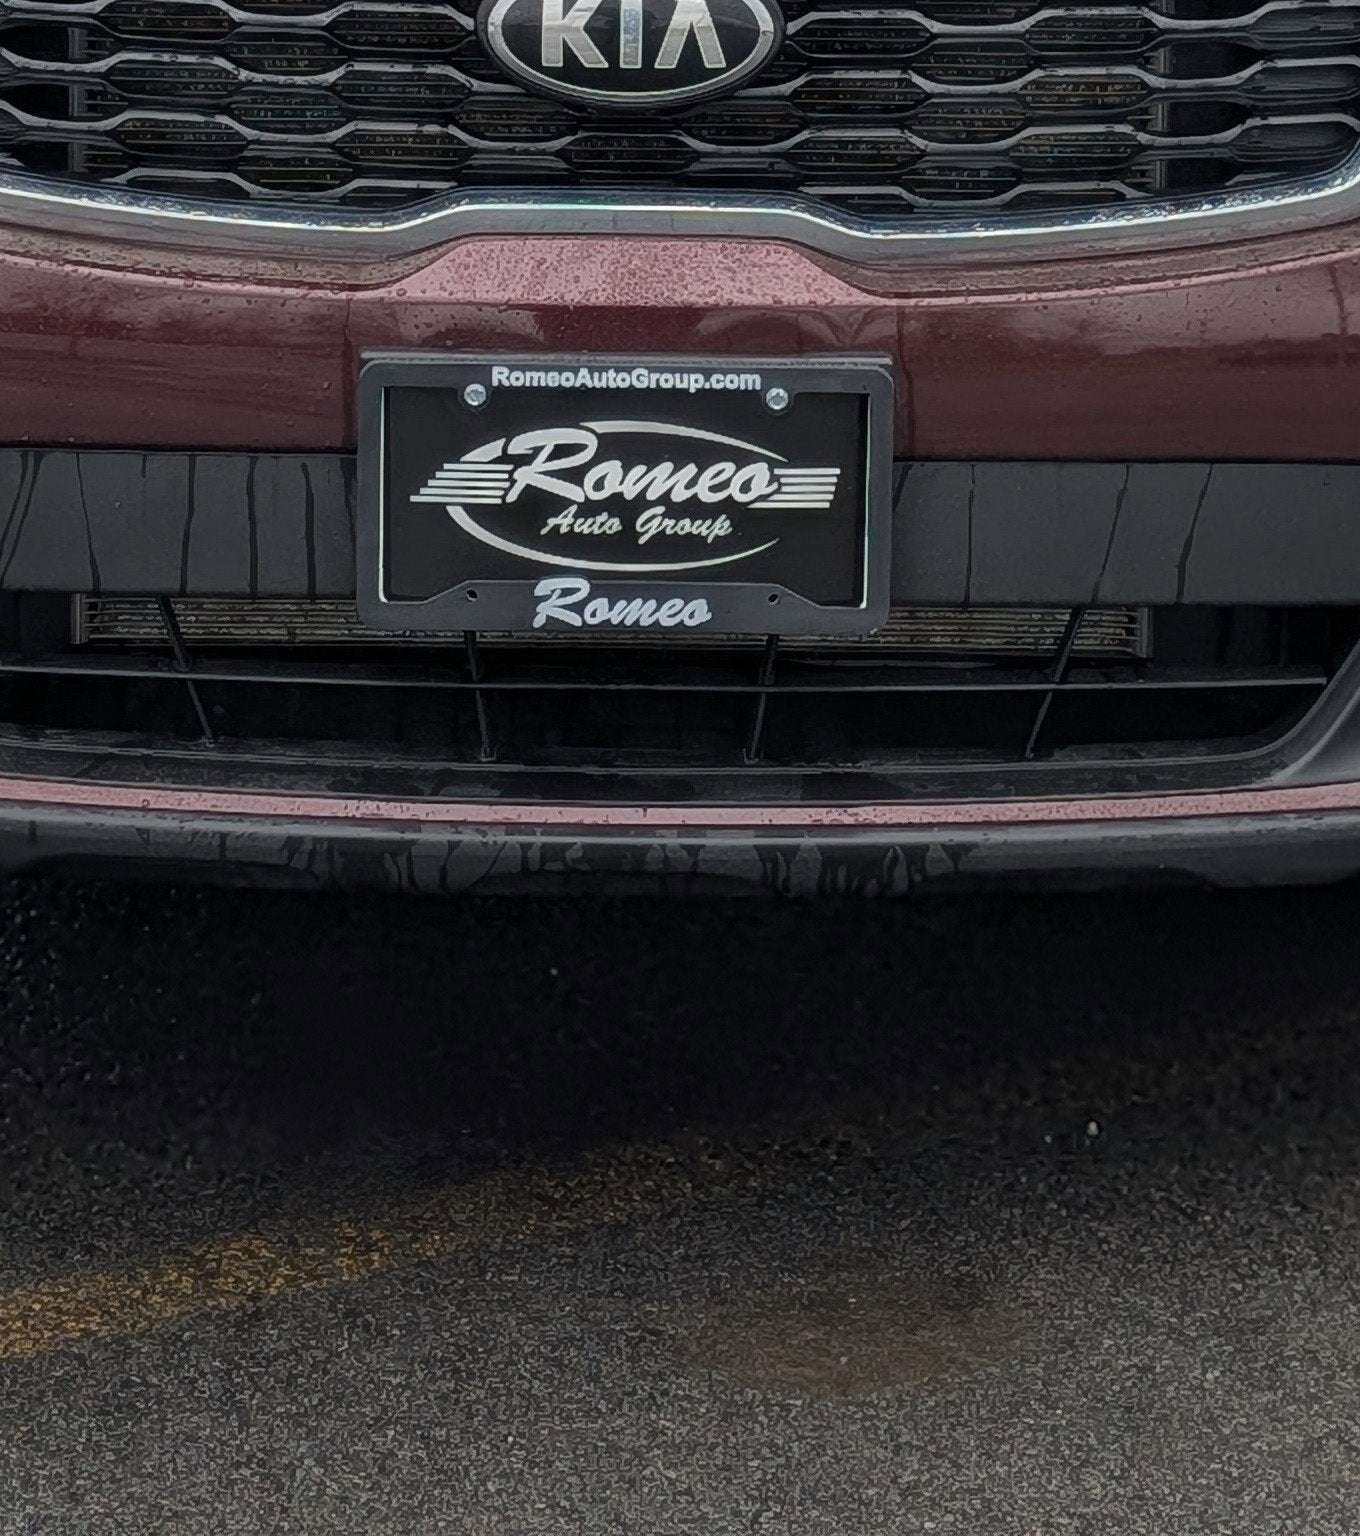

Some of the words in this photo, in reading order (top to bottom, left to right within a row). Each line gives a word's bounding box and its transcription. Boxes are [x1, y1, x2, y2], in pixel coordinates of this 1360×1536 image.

[492, 367, 761, 393] RomeoAutoGroup.com
[507, 429, 779, 503] Romeo
[541, 505, 622, 536] Auto
[637, 507, 733, 545] Group
[534, 577, 711, 627] Romeo
